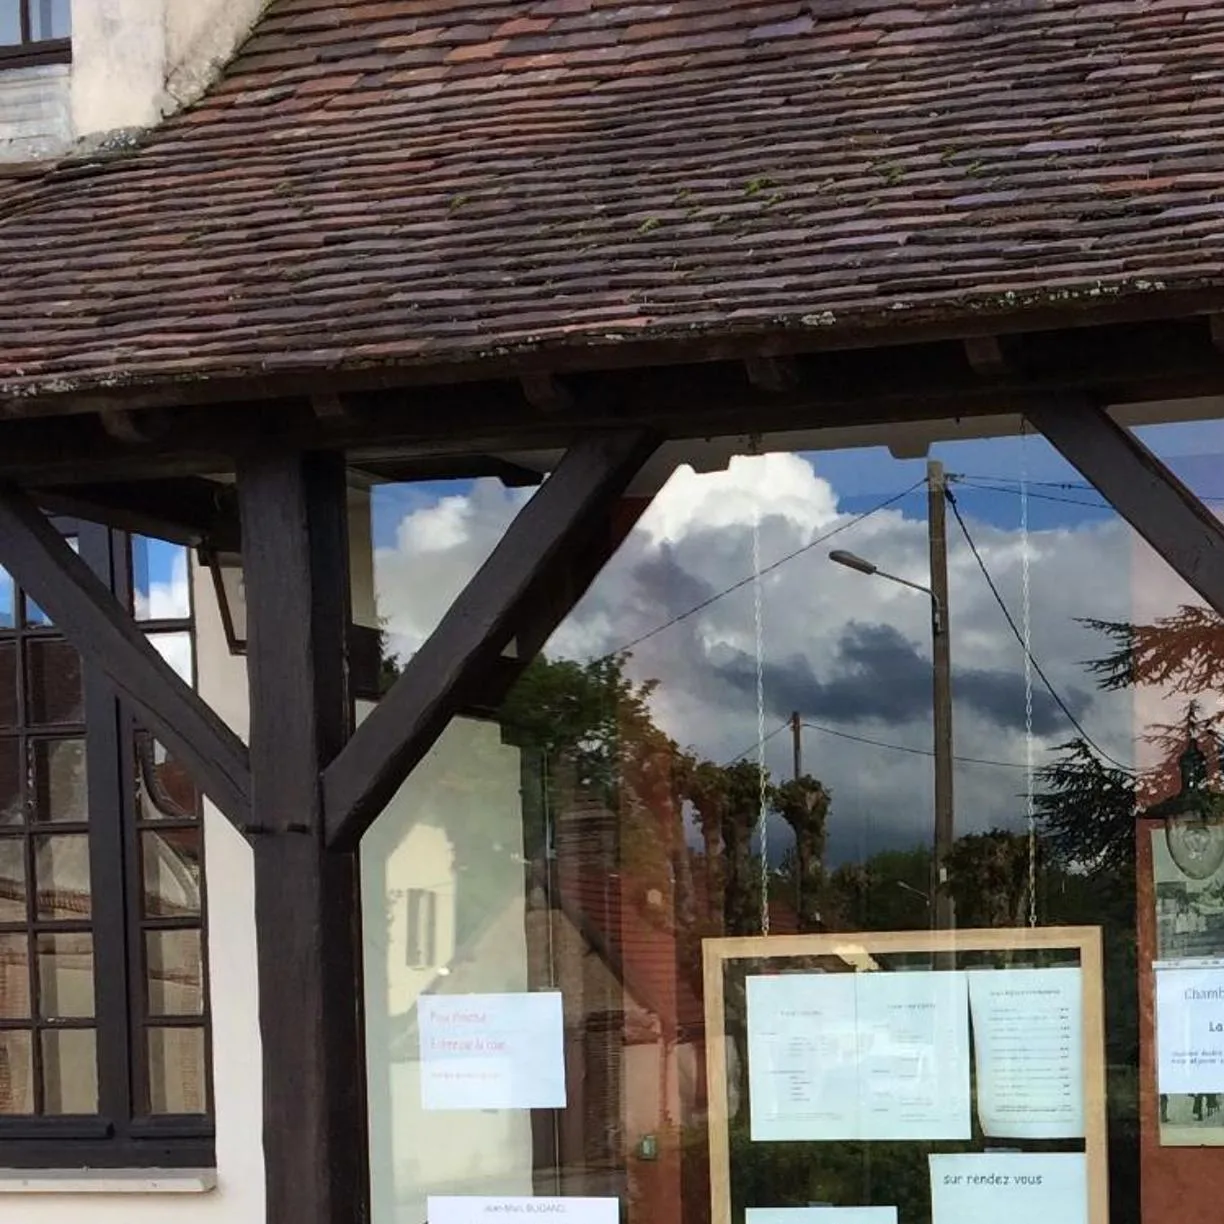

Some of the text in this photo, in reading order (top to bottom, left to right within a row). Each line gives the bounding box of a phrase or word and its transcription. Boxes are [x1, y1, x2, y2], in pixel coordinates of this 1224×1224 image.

[1208, 1021, 1224, 1032] La
[943, 1173, 1043, 1185] sur rendez vous
